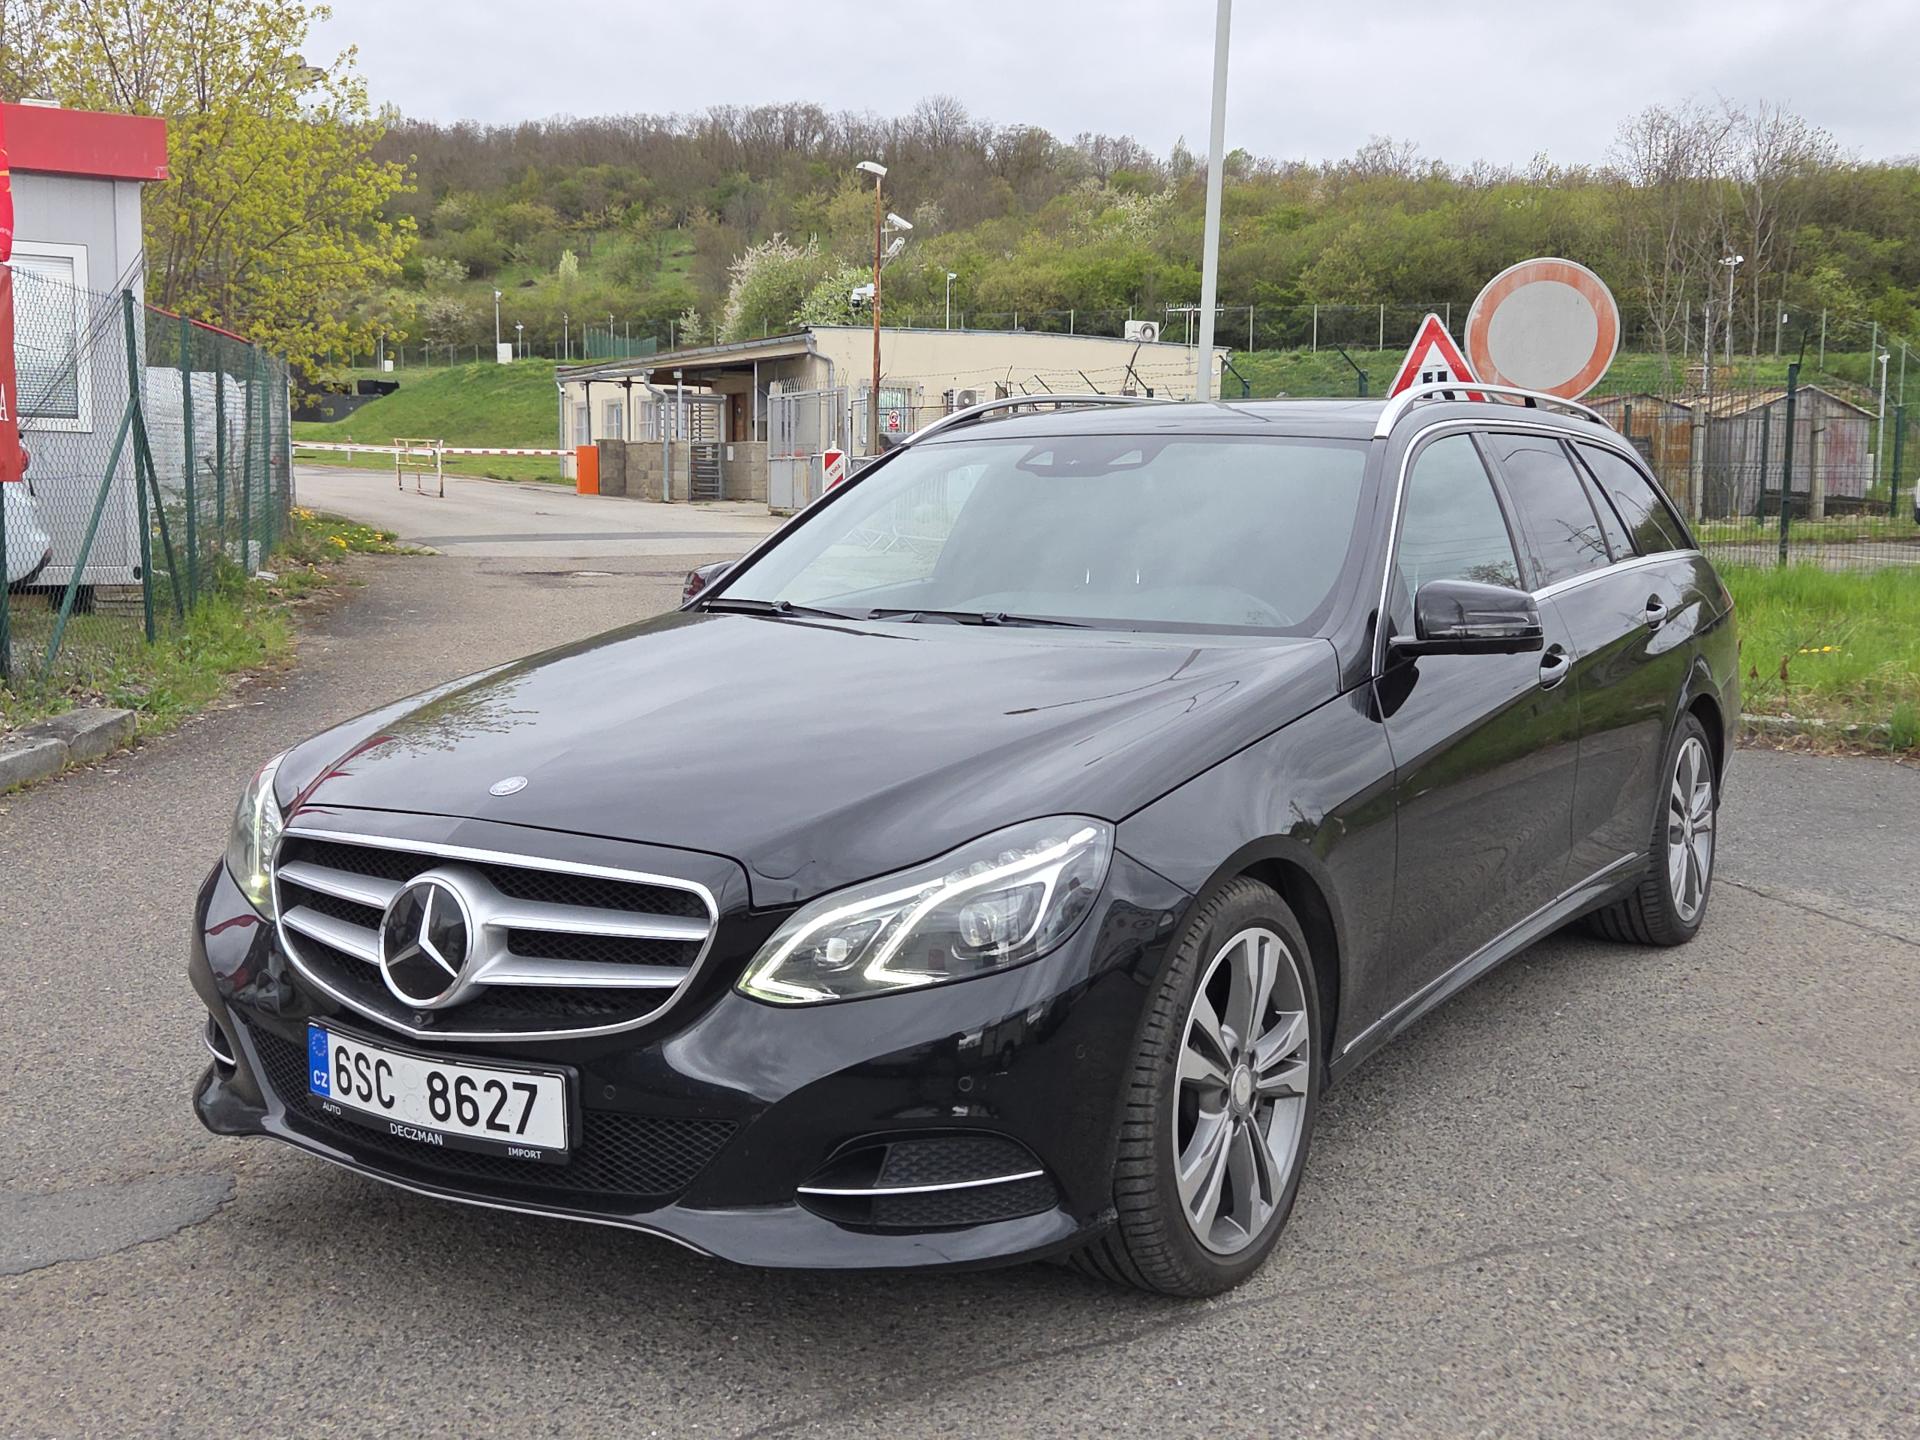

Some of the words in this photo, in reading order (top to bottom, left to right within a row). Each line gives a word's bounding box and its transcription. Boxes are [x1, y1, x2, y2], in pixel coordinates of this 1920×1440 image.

[313, 1070, 328, 1088] CZ
[334, 1045, 395, 1109] 6SC
[426, 1071, 538, 1135] 8627
[322, 1100, 342, 1116] AUTO
[389, 1122, 443, 1146] DECZMAN
[508, 1146, 542, 1160] IMPORT
